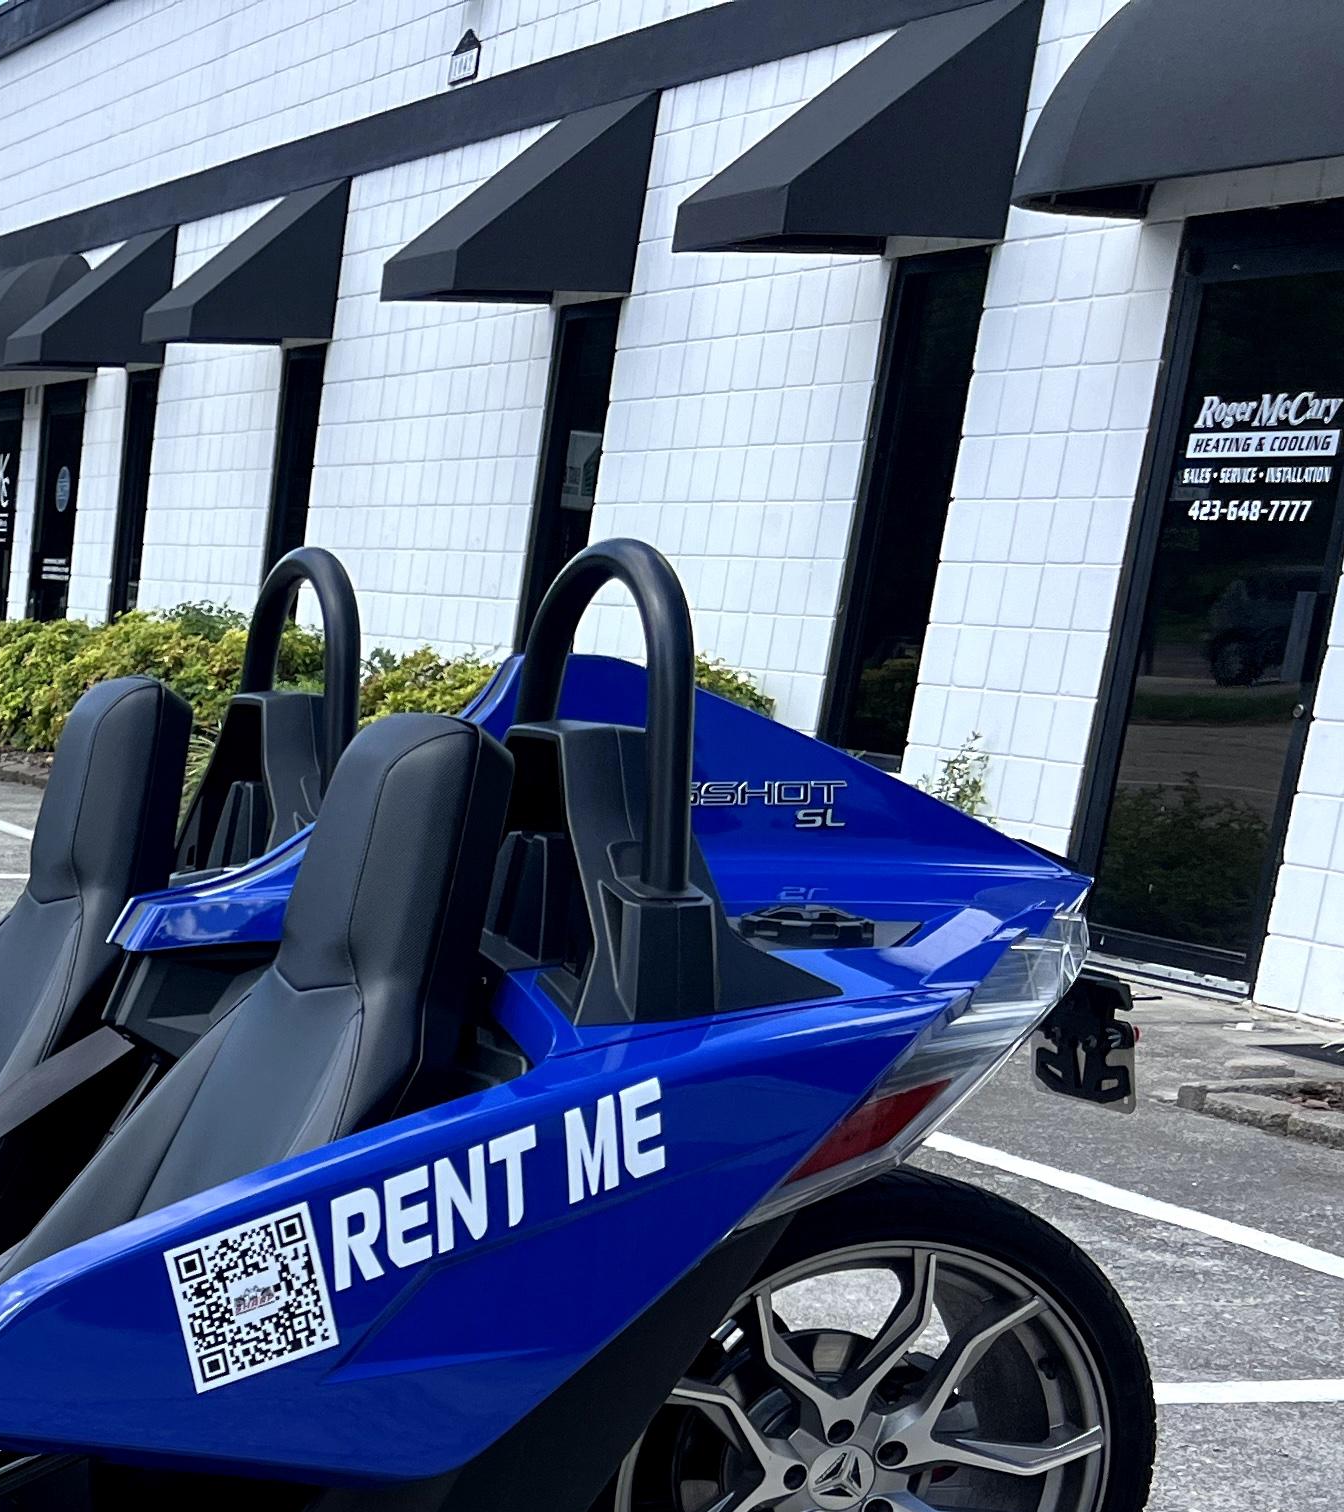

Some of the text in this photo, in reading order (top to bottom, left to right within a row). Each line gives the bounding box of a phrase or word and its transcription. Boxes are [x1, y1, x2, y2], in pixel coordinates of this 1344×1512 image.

[1194, 391, 1344, 429] Roger McCary
[1193, 435, 1333, 453] HEATING & COOLING
[1182, 466, 1332, 484] SALES SERVICE INSTALLATION
[1188, 500, 1312, 522] 423-648-7777
[795, 808, 846, 828] SL
[330, 1077, 667, 1293] RENT ME
